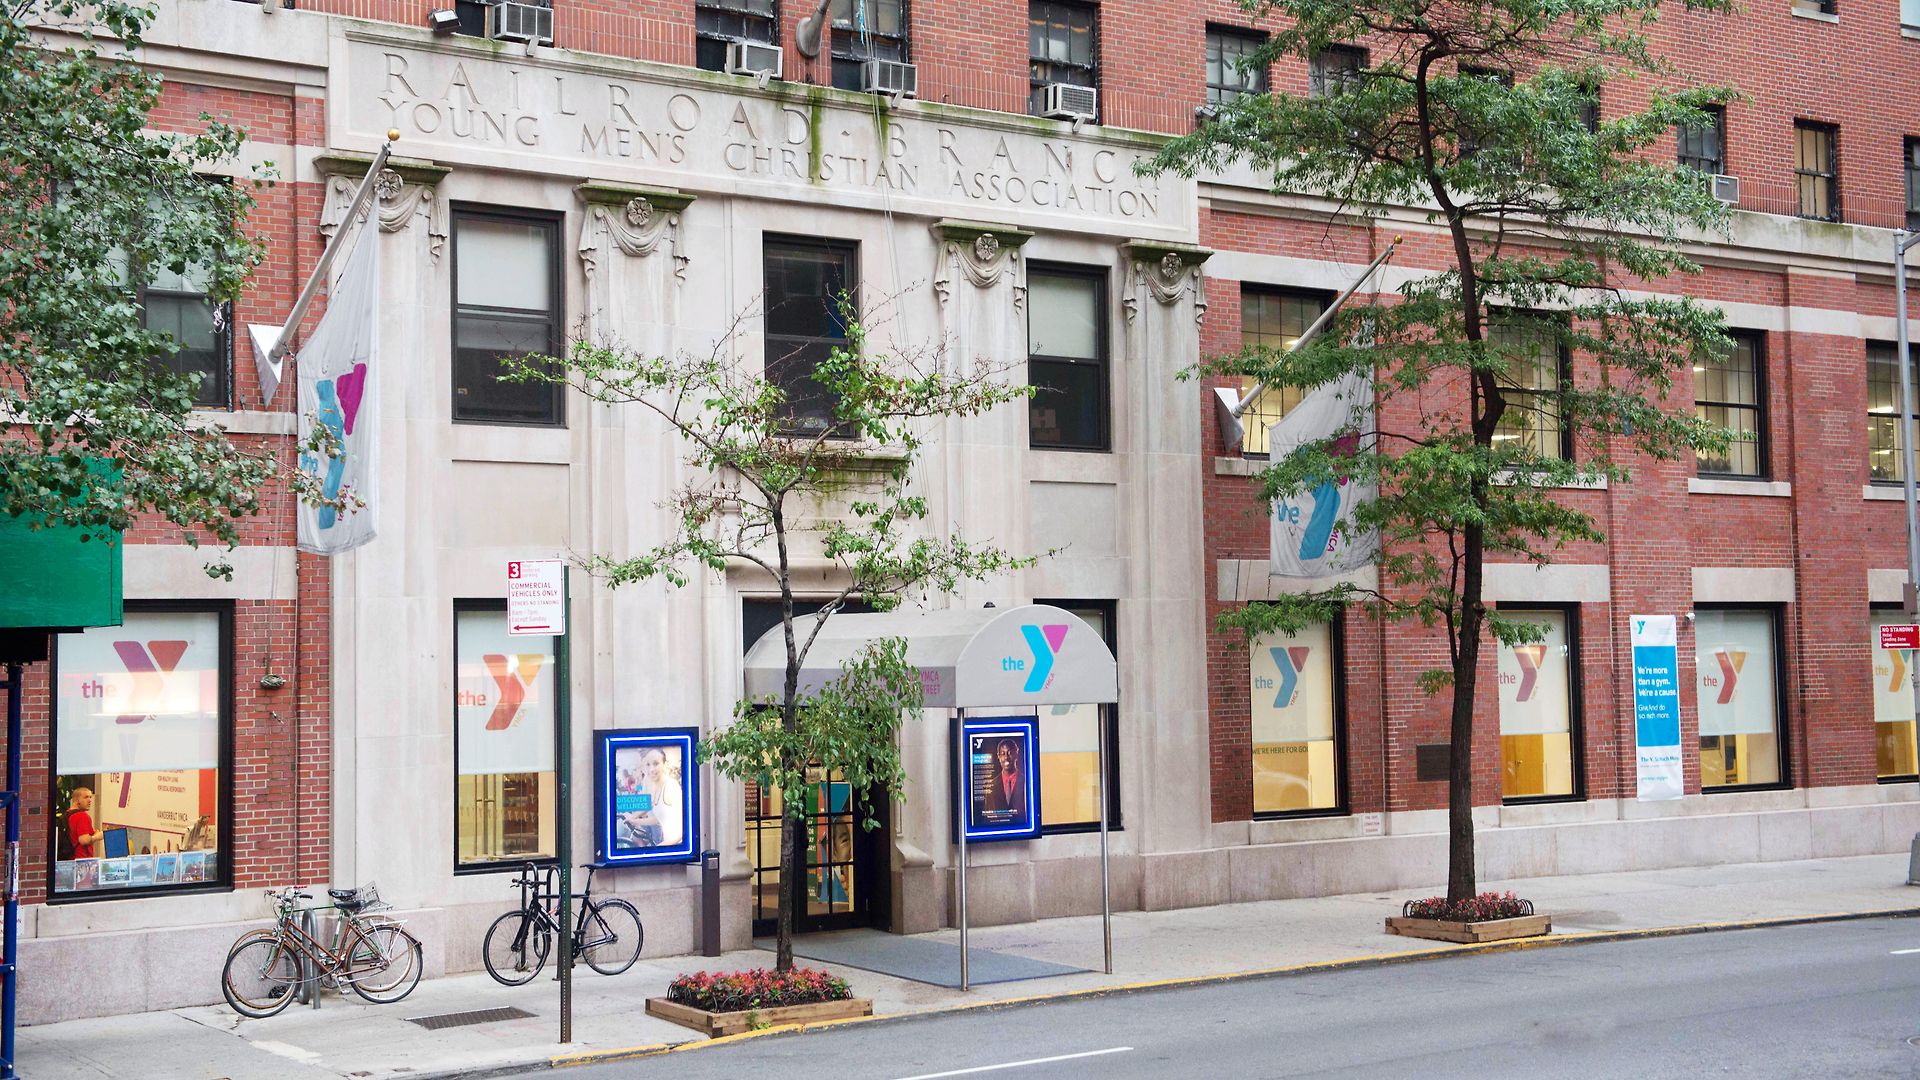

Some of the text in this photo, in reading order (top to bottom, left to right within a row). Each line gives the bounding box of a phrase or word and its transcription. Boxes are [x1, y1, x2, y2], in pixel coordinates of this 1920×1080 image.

[382, 52, 811, 146] RAILROAD
[378, 96, 1159, 218] YOUNG MEN'S CHRISTIAN ASSOCIATION
[509, 563, 519, 577] 3
[1002, 655, 1025, 671] the
[921, 670, 940, 682] YMCA
[1255, 675, 1273, 689] the
[1498, 671, 1516, 684] the
[1703, 675, 1718, 687] the
[922, 684, 940, 695] TREET
[458, 689, 486, 706] the
